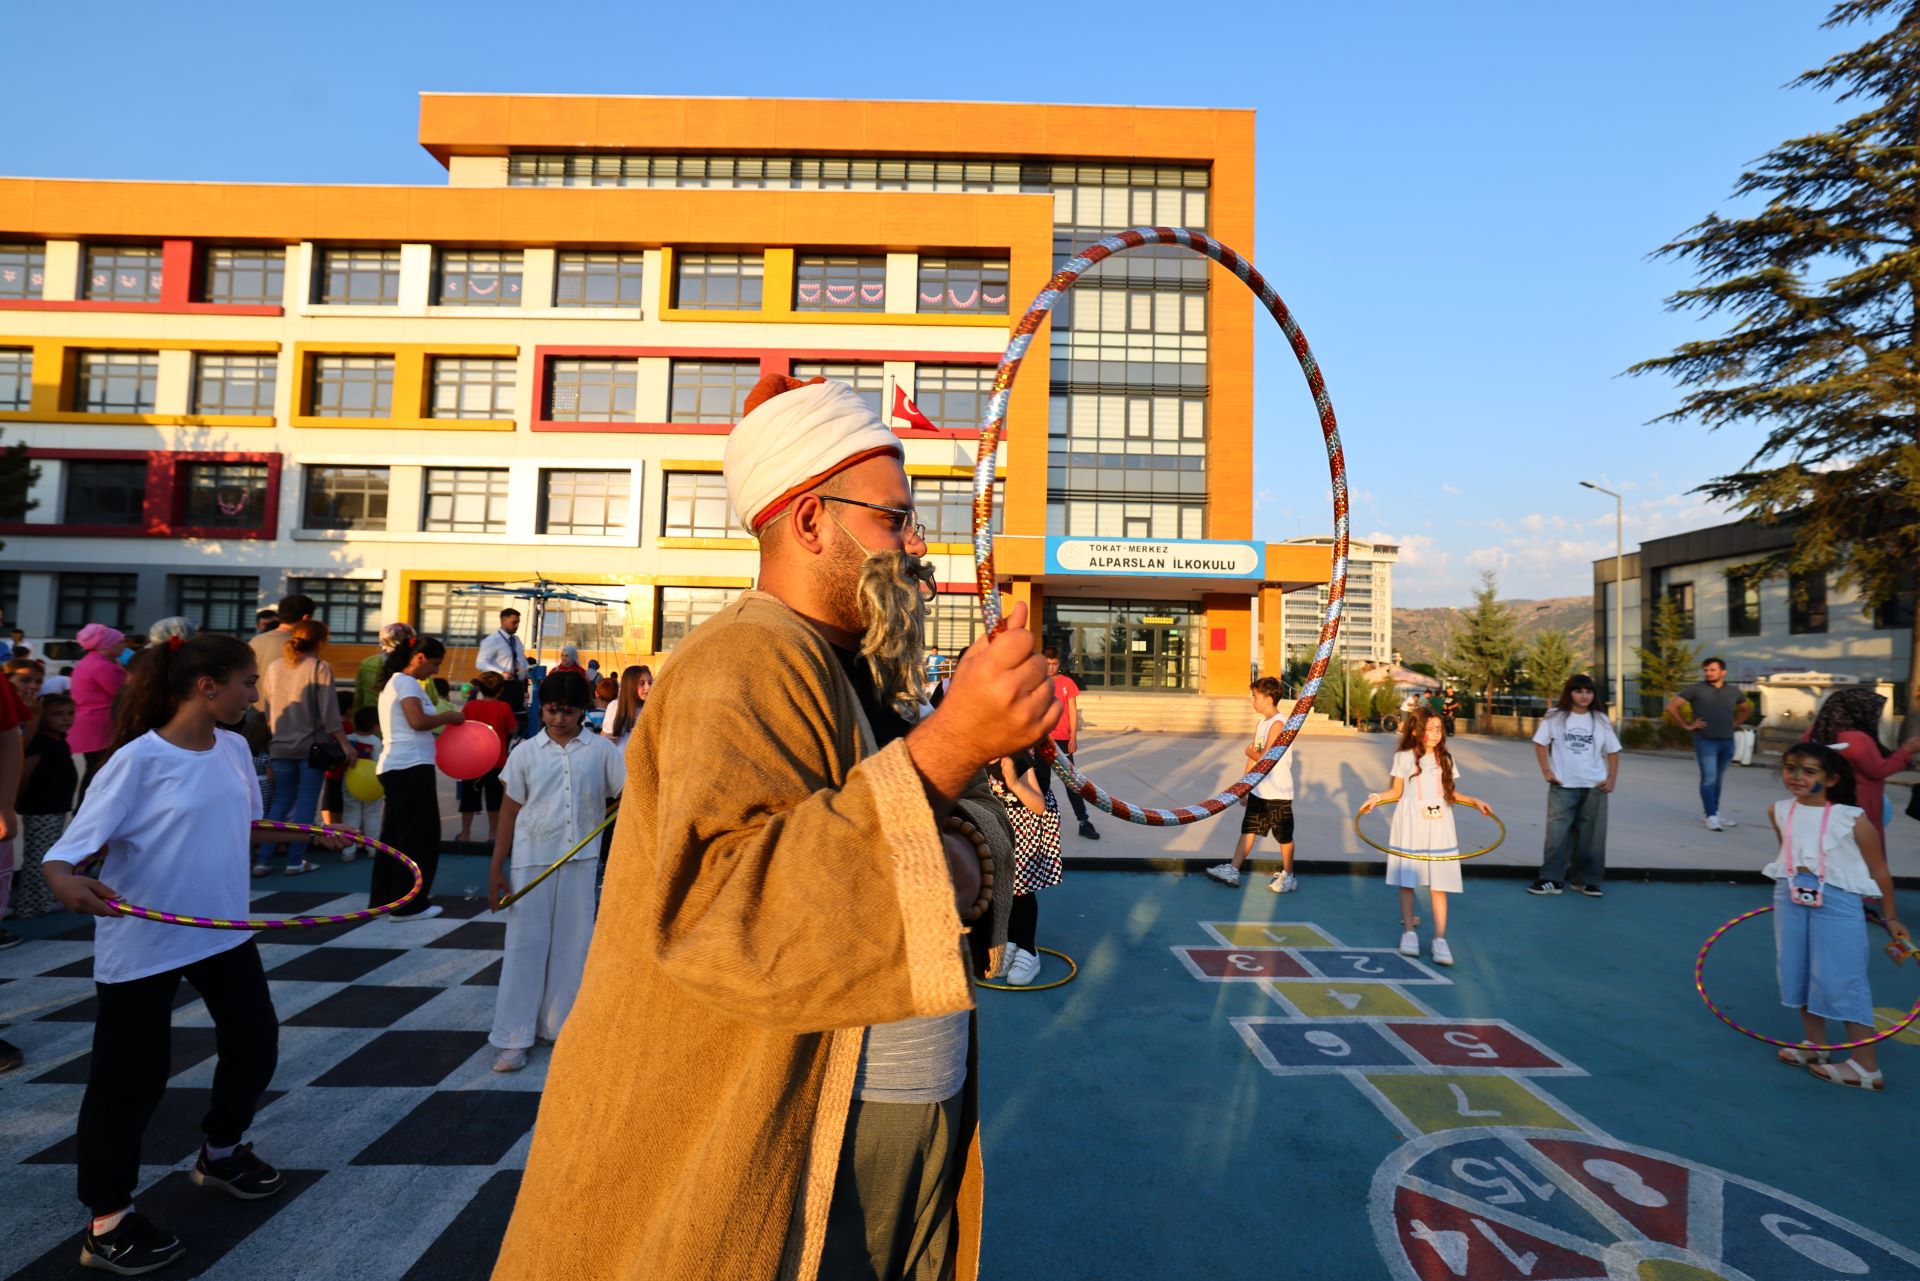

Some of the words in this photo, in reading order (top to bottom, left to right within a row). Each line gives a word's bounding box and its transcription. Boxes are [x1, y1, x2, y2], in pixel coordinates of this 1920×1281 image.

[1089, 556, 1165, 569] ALPARSLAN
[1173, 556, 1236, 570] İLKOKULU
[1226, 953, 1265, 972] 3
[1341, 955, 1385, 974] 2
[1443, 1031, 1499, 1059] 5
[1583, 1158, 1668, 1208] 8
